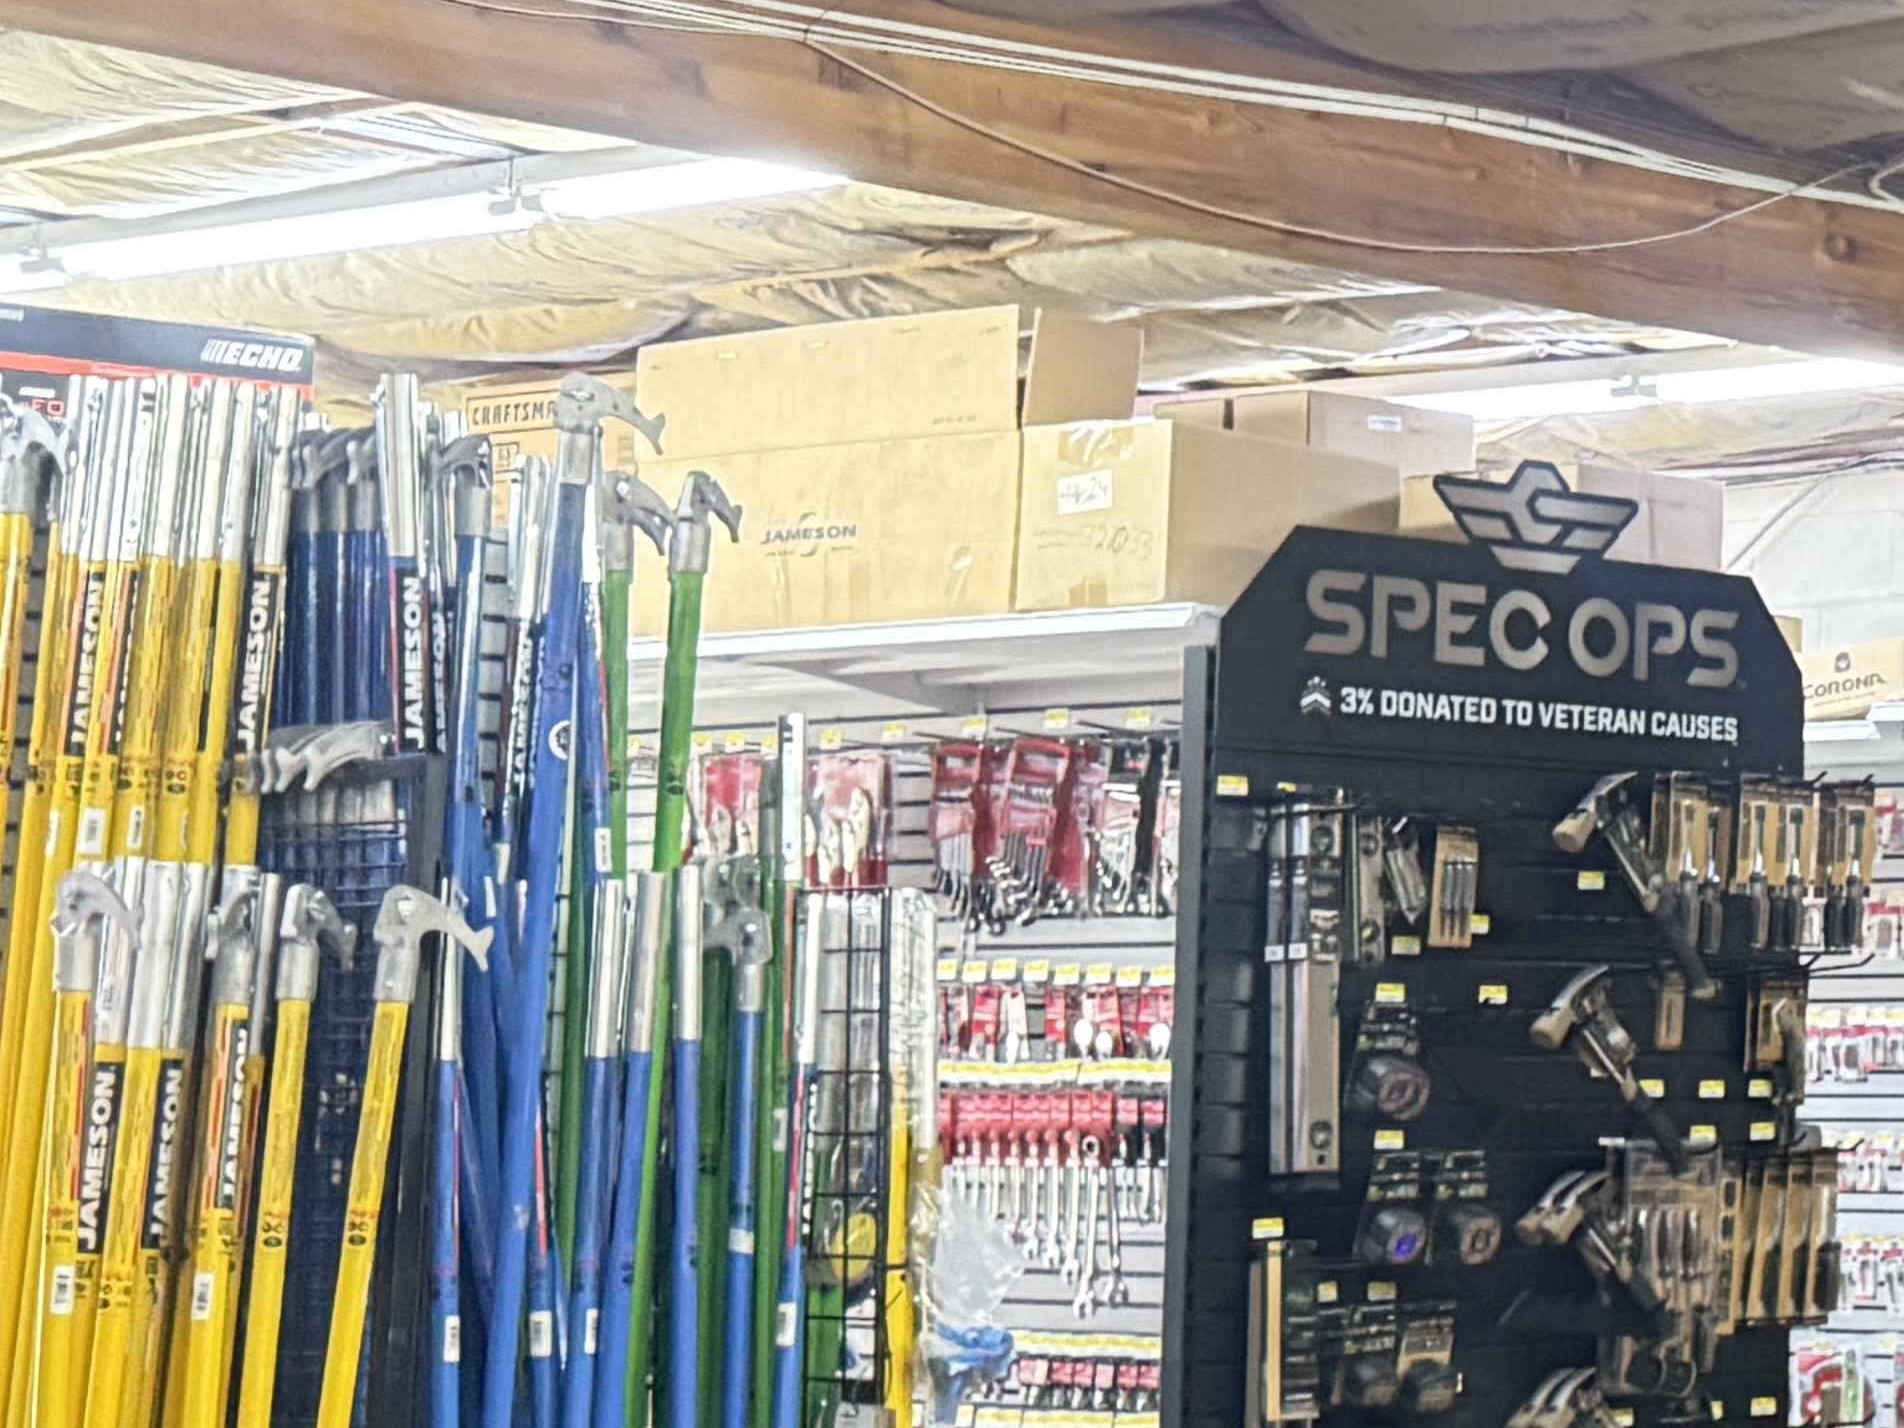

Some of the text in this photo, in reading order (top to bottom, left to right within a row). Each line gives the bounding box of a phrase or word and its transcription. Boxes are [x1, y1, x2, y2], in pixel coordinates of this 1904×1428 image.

[221, 339, 304, 373] ECHO
[761, 520, 858, 548] JAMESON
[69, 572, 104, 752] JAMESON
[237, 581, 271, 752] JAMESON
[403, 575, 425, 751] JAMESON
[1303, 569, 1740, 689] SPEC OPS
[1339, 686, 1739, 743] 3% DONATED TO VETERAN CAUSES
[77, 1070, 117, 1251] JAMESON
[150, 1068, 184, 1237] JAMESON
